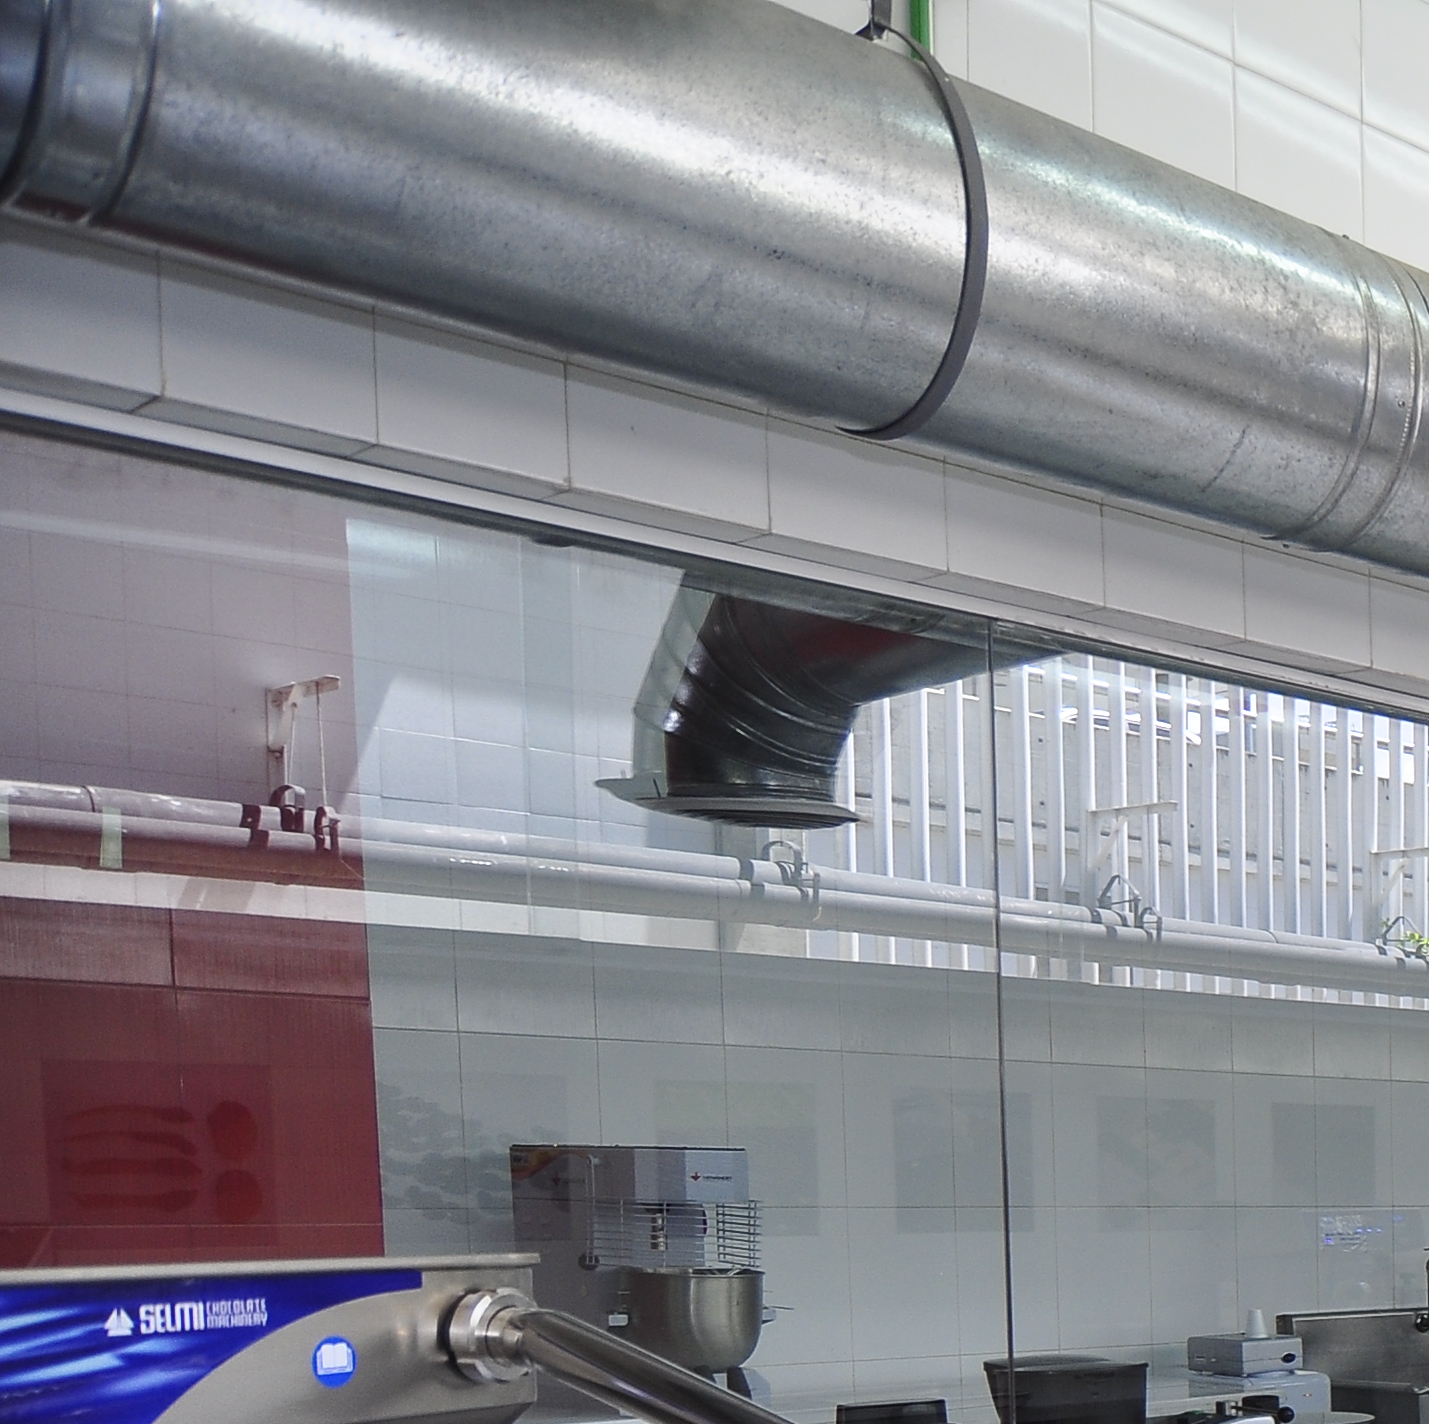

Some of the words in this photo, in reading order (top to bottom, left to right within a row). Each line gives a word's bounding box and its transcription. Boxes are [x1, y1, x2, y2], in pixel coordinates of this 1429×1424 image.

[206, 1298, 266, 1316] CHOCOLATE
[139, 1301, 205, 1334] SELMI
[206, 1311, 267, 1329] MACHINERY
